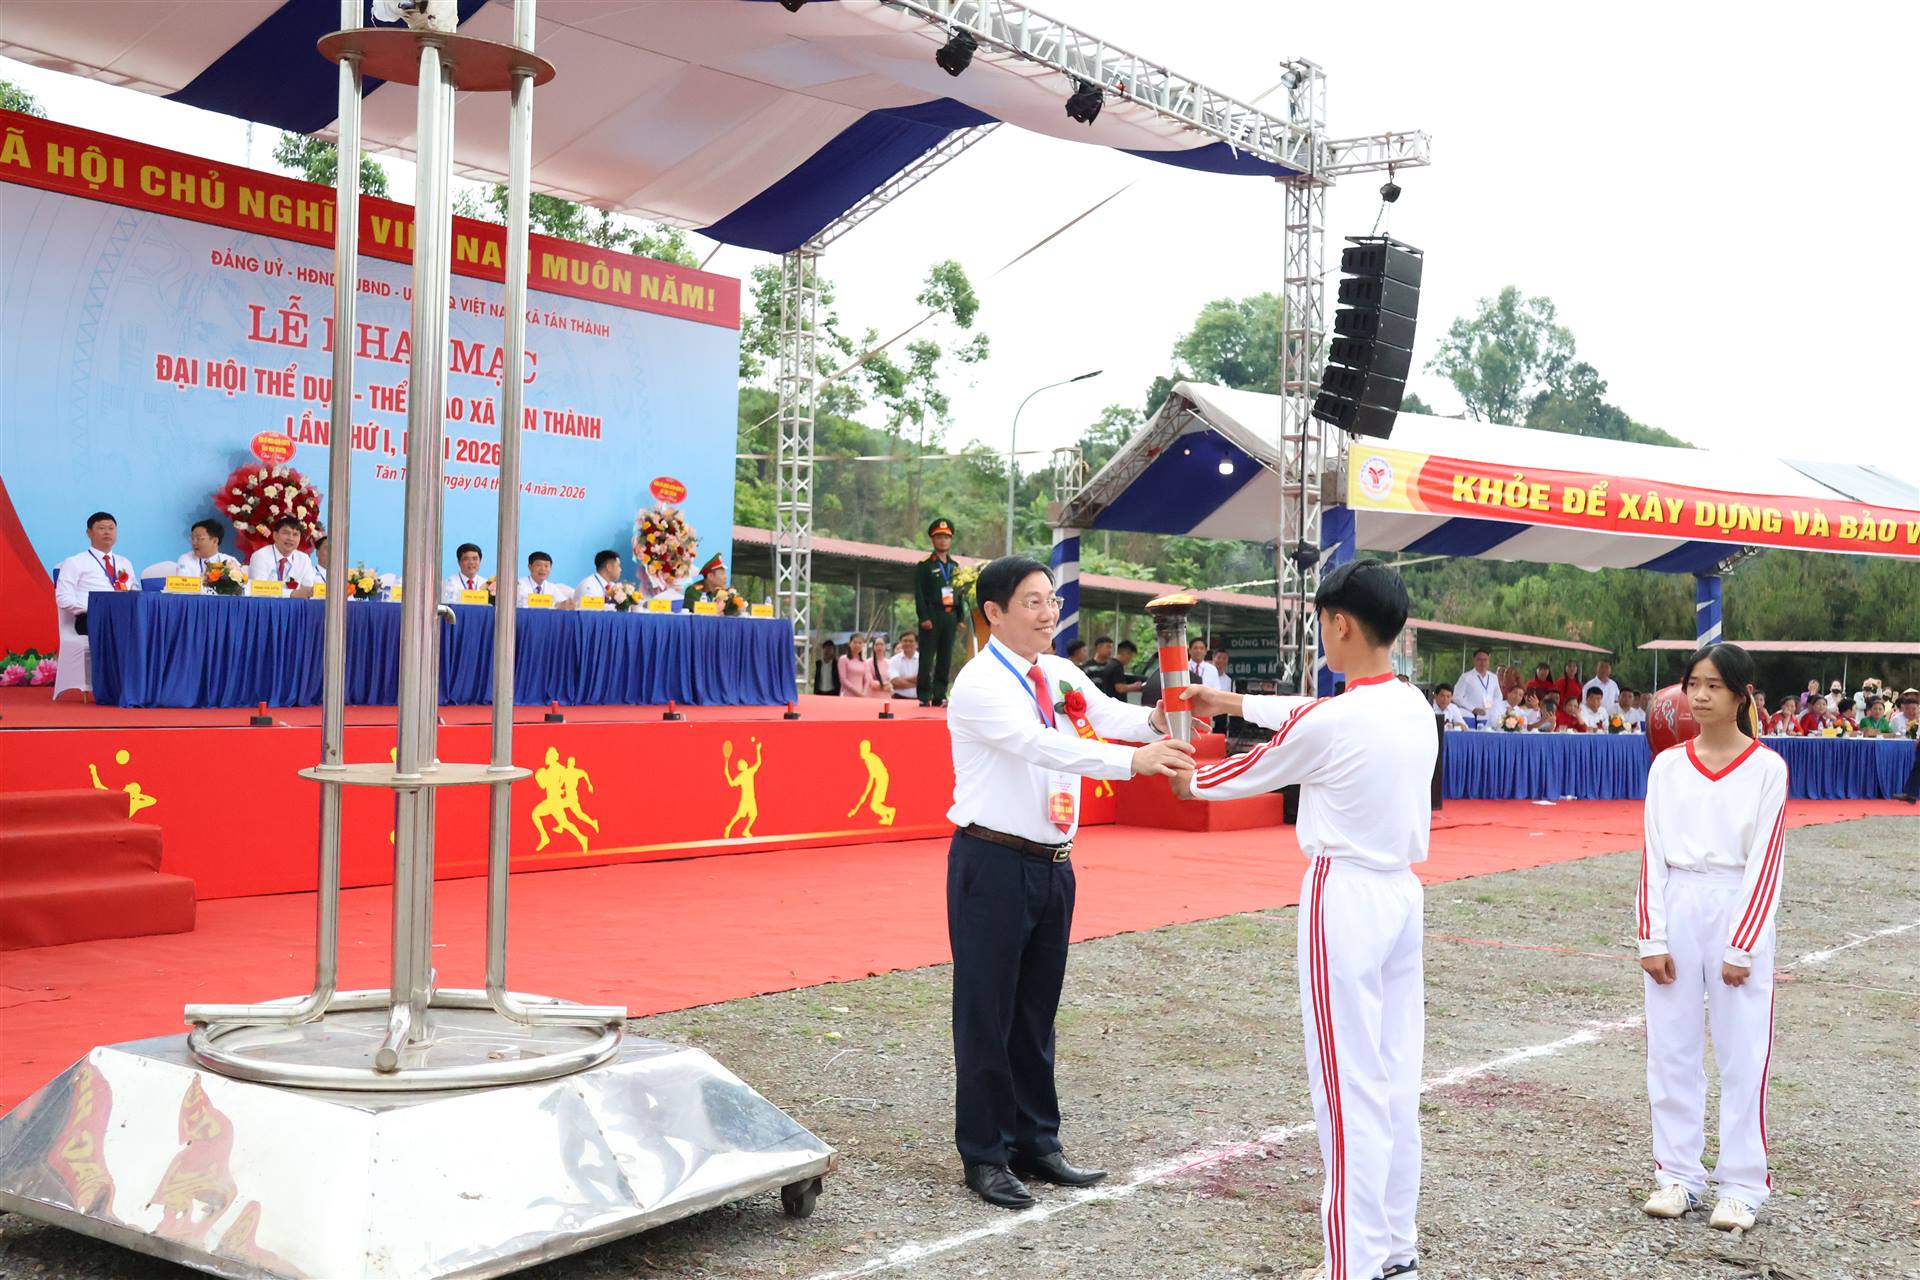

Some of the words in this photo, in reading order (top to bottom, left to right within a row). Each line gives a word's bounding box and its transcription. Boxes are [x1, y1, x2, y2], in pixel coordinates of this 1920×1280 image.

[47, 142, 125, 190] HỘI
[140, 165, 225, 209] CHỦ
[239, 185, 334, 233] NGHĨ
[456, 234, 531, 275] NA
[541, 253, 631, 295] MUÔN
[640, 273, 716, 312] NĂM!
[211, 248, 259, 272] ĐẢNG
[264, 257, 283, 277] UỶ
[460, 297, 486, 318] VIỆT
[489, 304, 505, 318] NA
[571, 318, 610, 338] THÀNH
[248, 296, 308, 349] LỄ
[156, 354, 198, 389] ĐẠI
[206, 359, 246, 396] HỘI
[254, 363, 298, 398] THỂ
[303, 375, 333, 408] DỤ
[369, 380, 408, 413] THỂ
[469, 397, 495, 425] XÃ
[543, 409, 601, 439] THÀNH
[286, 410, 330, 445] LẦN
[351, 421, 380, 451] HỨ
[383, 429, 396, 457] I,
[456, 439, 501, 466] 2026
[375, 464, 397, 480] Tân
[443, 474, 471, 491] ngày
[473, 476, 487, 489] 04
[524, 481, 532, 493] 4
[533, 483, 557, 496] năm
[559, 485, 586, 499] 2026
[1452, 472, 1551, 511] KHỎE
[1562, 480, 1609, 517] ĐỂ
[1618, 490, 1685, 525] XÂY
[1695, 500, 1783, 534] DỰNG
[1791, 507, 1830, 538] VÀ
[1838, 509, 1899, 544] BẢO
